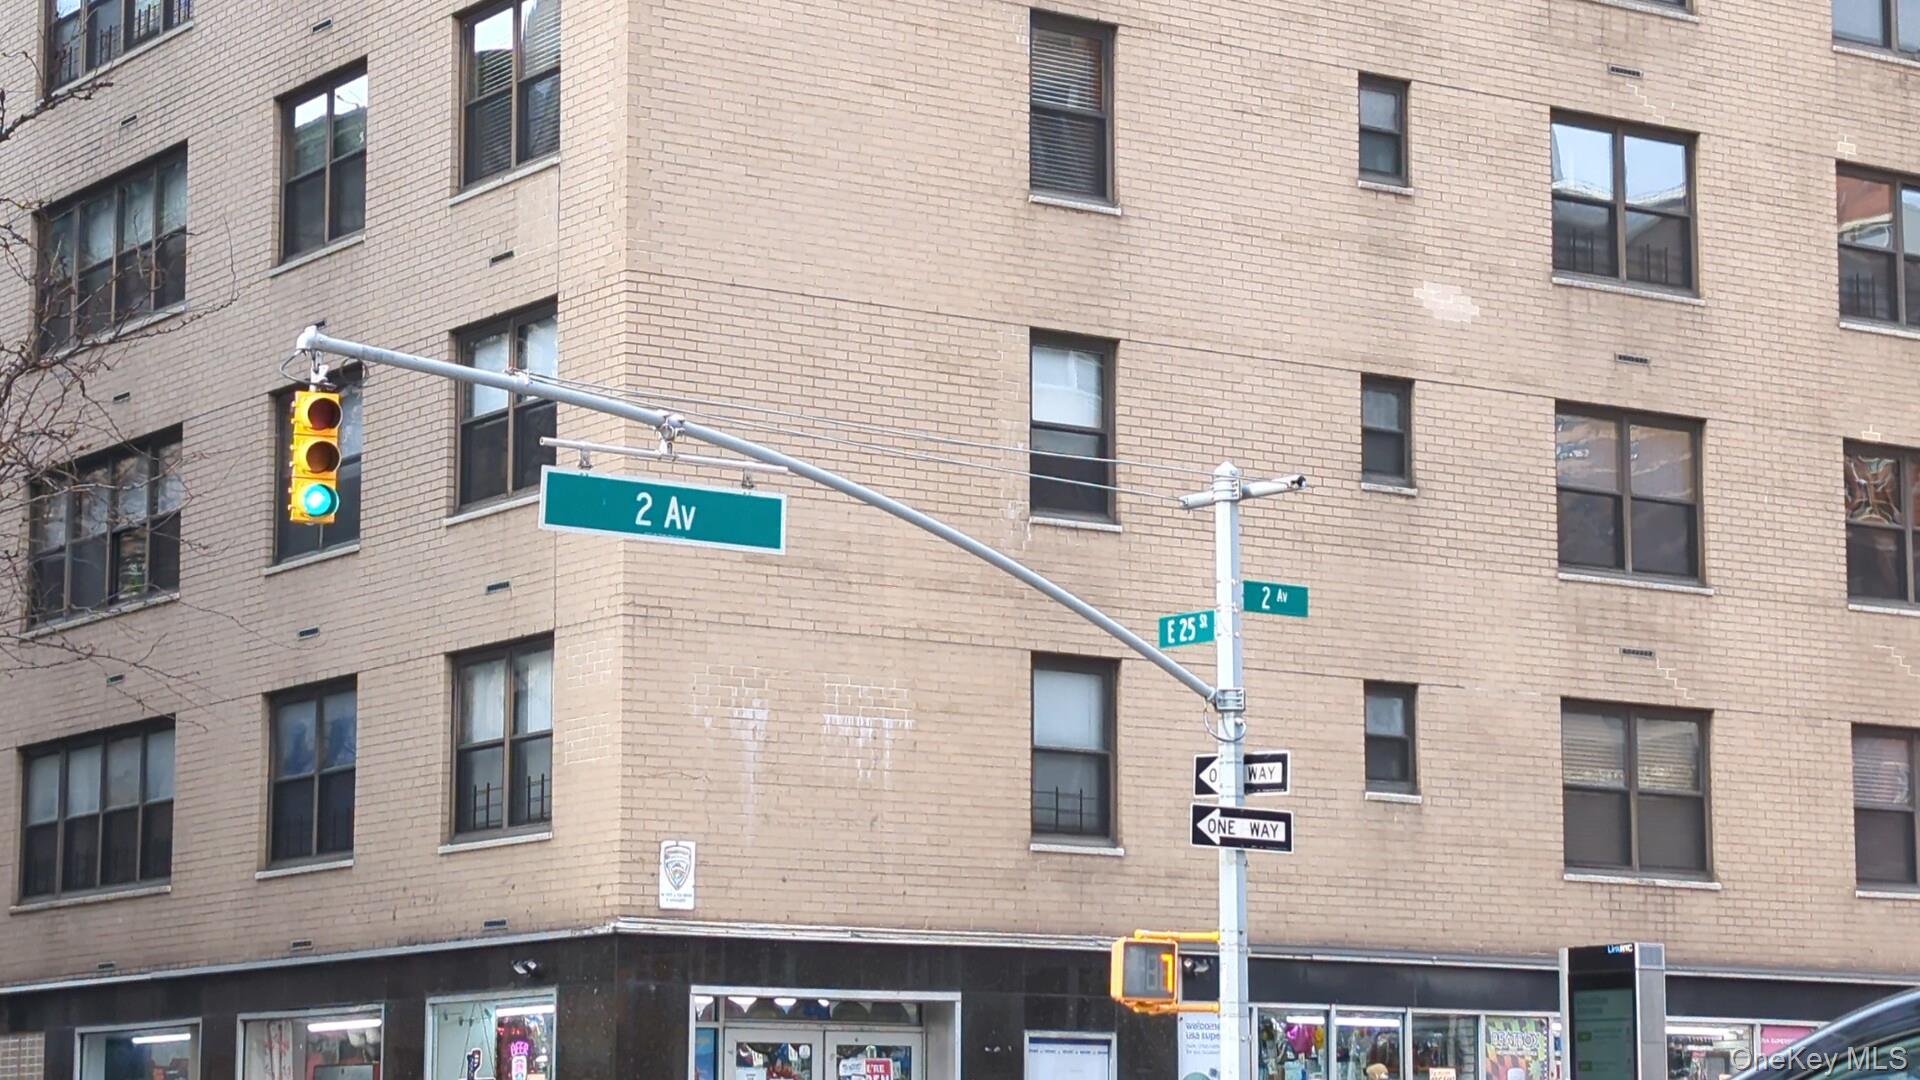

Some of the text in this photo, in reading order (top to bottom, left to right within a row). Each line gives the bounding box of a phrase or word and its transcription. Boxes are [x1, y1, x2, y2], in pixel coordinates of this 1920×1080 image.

[635, 491, 696, 531] 2 Av
[1261, 586, 1271, 610] 2
[1167, 619, 1175, 644] E
[1179, 616, 1196, 642] 25
[1247, 765, 1276, 782] WAY
[1207, 818, 1279, 838] ONE WAY
